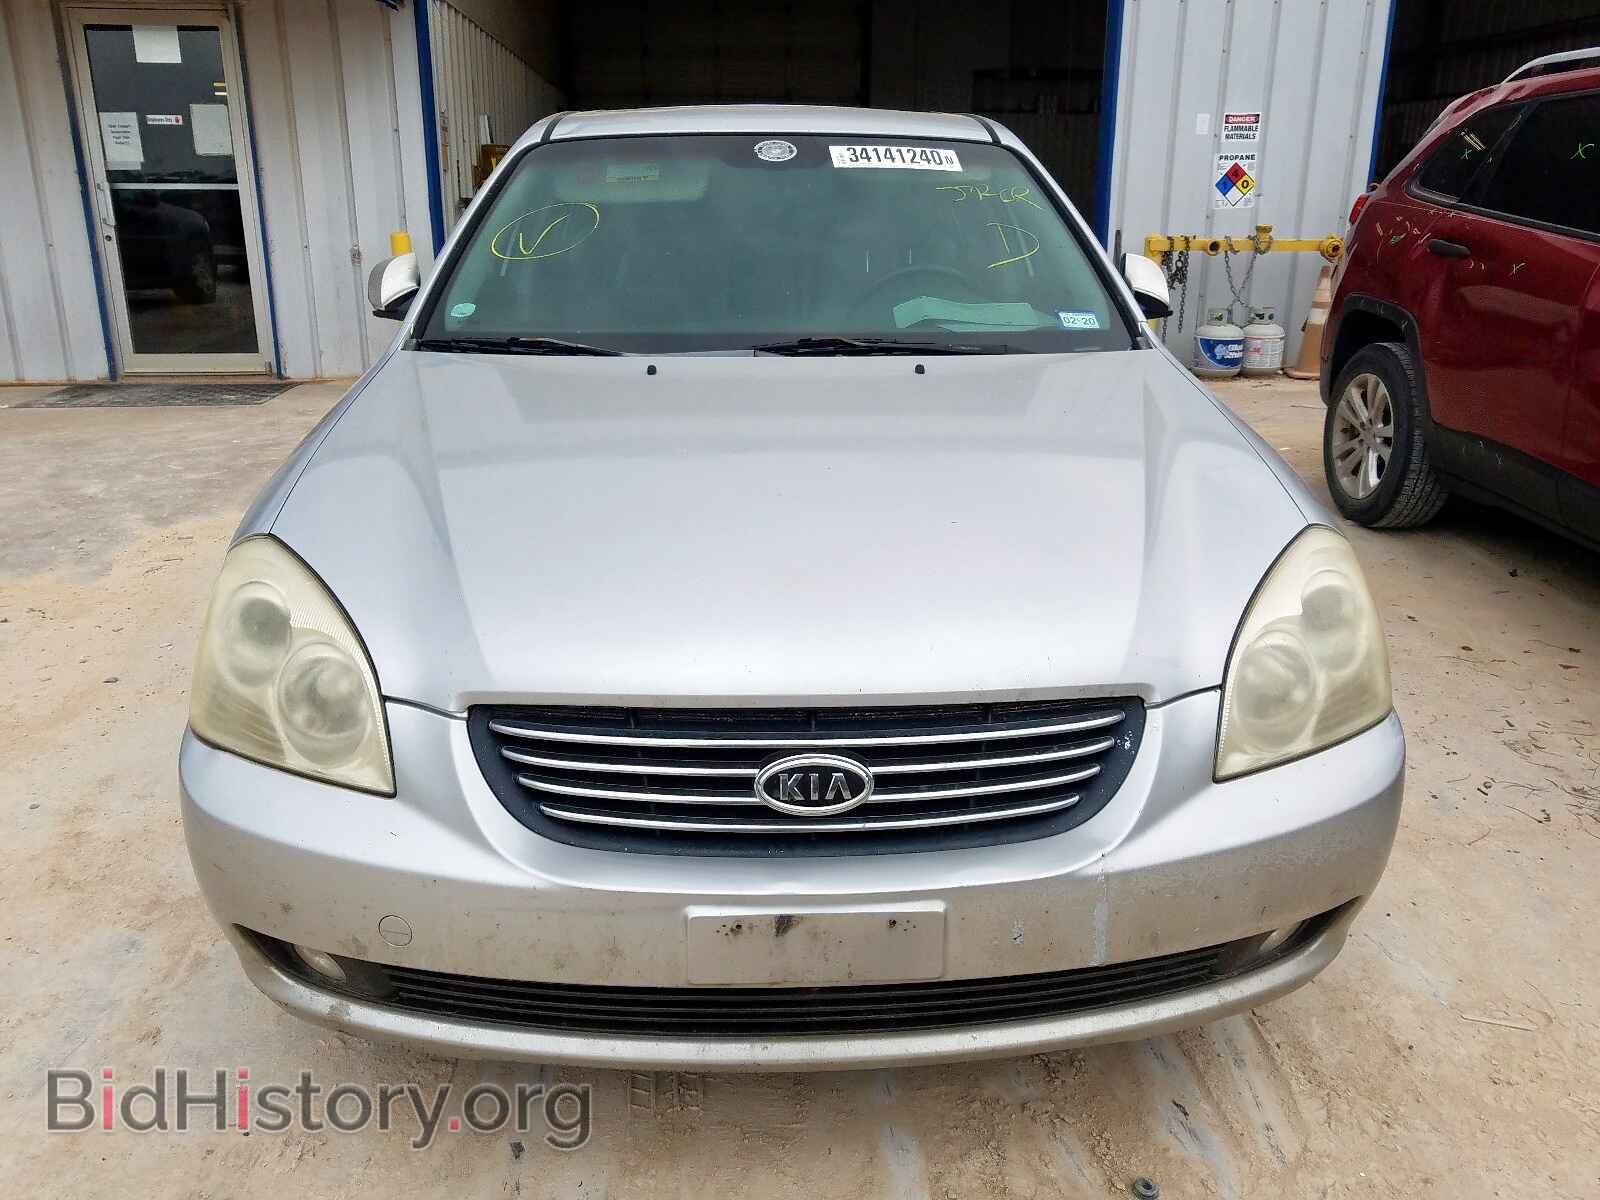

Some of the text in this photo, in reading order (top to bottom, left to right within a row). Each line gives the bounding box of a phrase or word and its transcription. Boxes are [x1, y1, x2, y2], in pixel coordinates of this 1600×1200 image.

[846, 147, 943, 165] 34141240
[1241, 179, 1249, 189] 0
[778, 772, 852, 801] KIA
